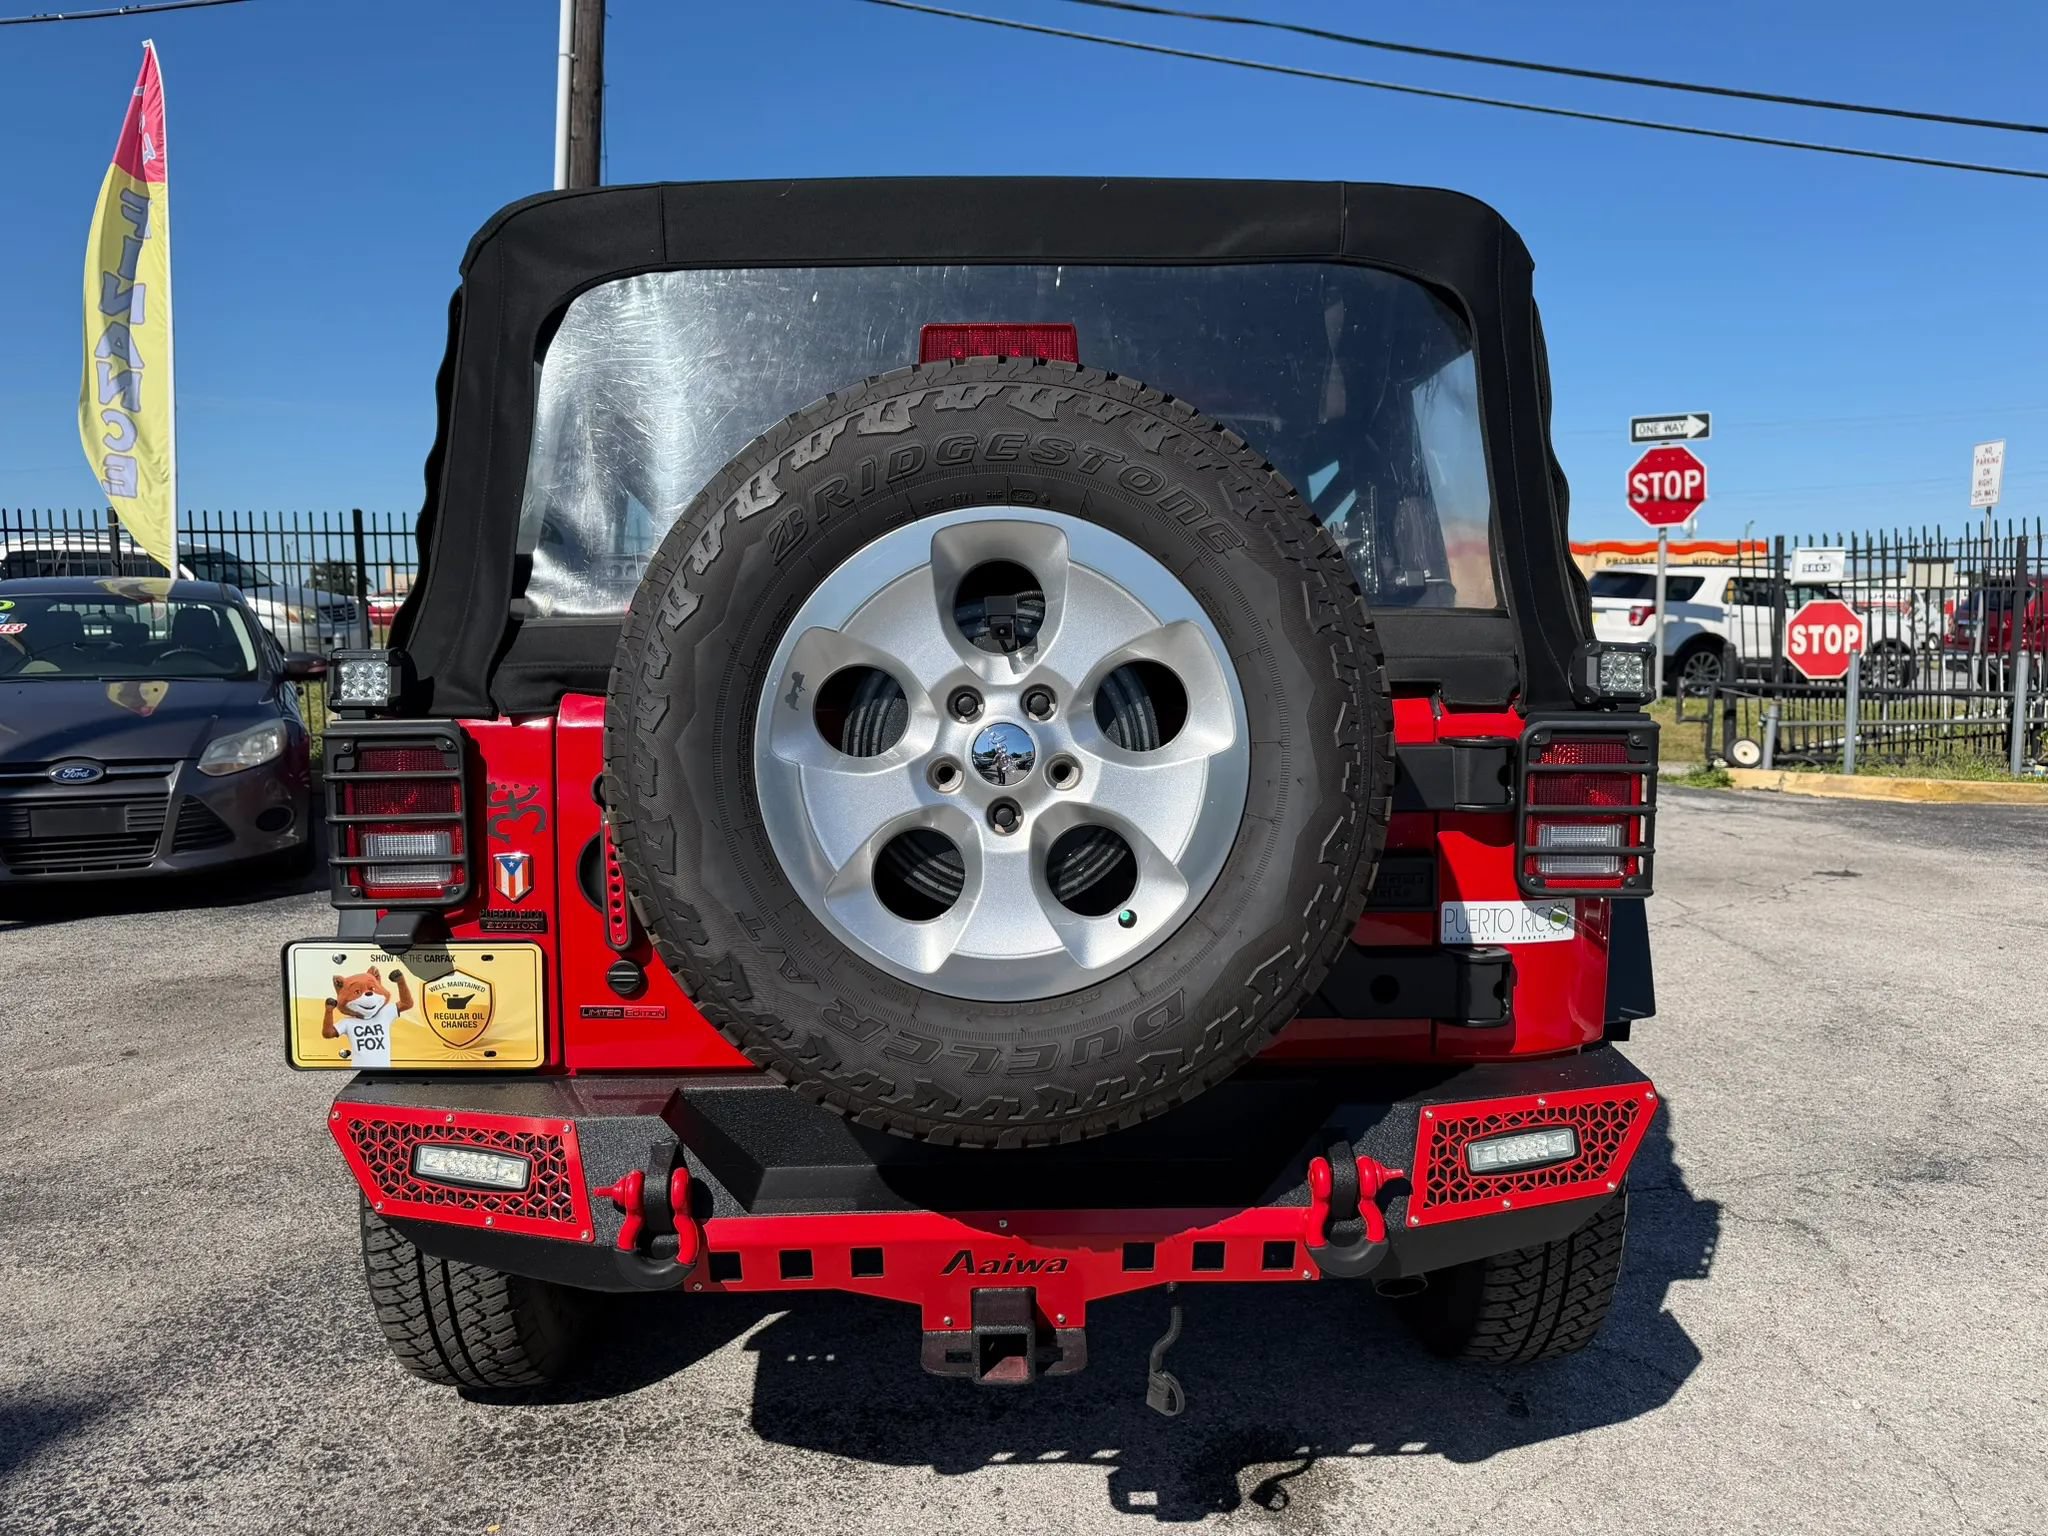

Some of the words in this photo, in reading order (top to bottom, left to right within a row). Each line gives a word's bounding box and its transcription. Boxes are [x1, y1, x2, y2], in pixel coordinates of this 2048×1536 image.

[1638, 423, 1658, 435] ONE
[1664, 421, 1686, 433] WAY
[1985, 446, 1993, 455] NO
[1976, 456, 1999, 466] PARKING
[1632, 469, 1702, 504] STOP
[766, 430, 1249, 567] BRIDGESTONE
[1791, 624, 1860, 655] STOP
[62, 768, 90, 779] Ford
[486, 921, 538, 930] EDITION
[1444, 908, 1514, 934] PUERTO
[370, 954, 394, 963] SHOW
[409, 954, 423, 964] THE
[424, 954, 456, 964] CARFAX
[428, 983, 446, 993] WELL
[447, 981, 486, 993] MAINTAINED
[434, 1012, 470, 1021] REGULAR
[472, 1012, 485, 1021] OIL
[582, 1008, 622, 1017] LIMITED
[625, 1008, 665, 1017] EDITION
[354, 1023, 385, 1038] CAR
[441, 1020, 478, 1029] CHANGES
[820, 986, 1187, 1078] DUELER
[356, 1037, 386, 1051] FOX
[940, 1249, 1069, 1276] Aaiwa
